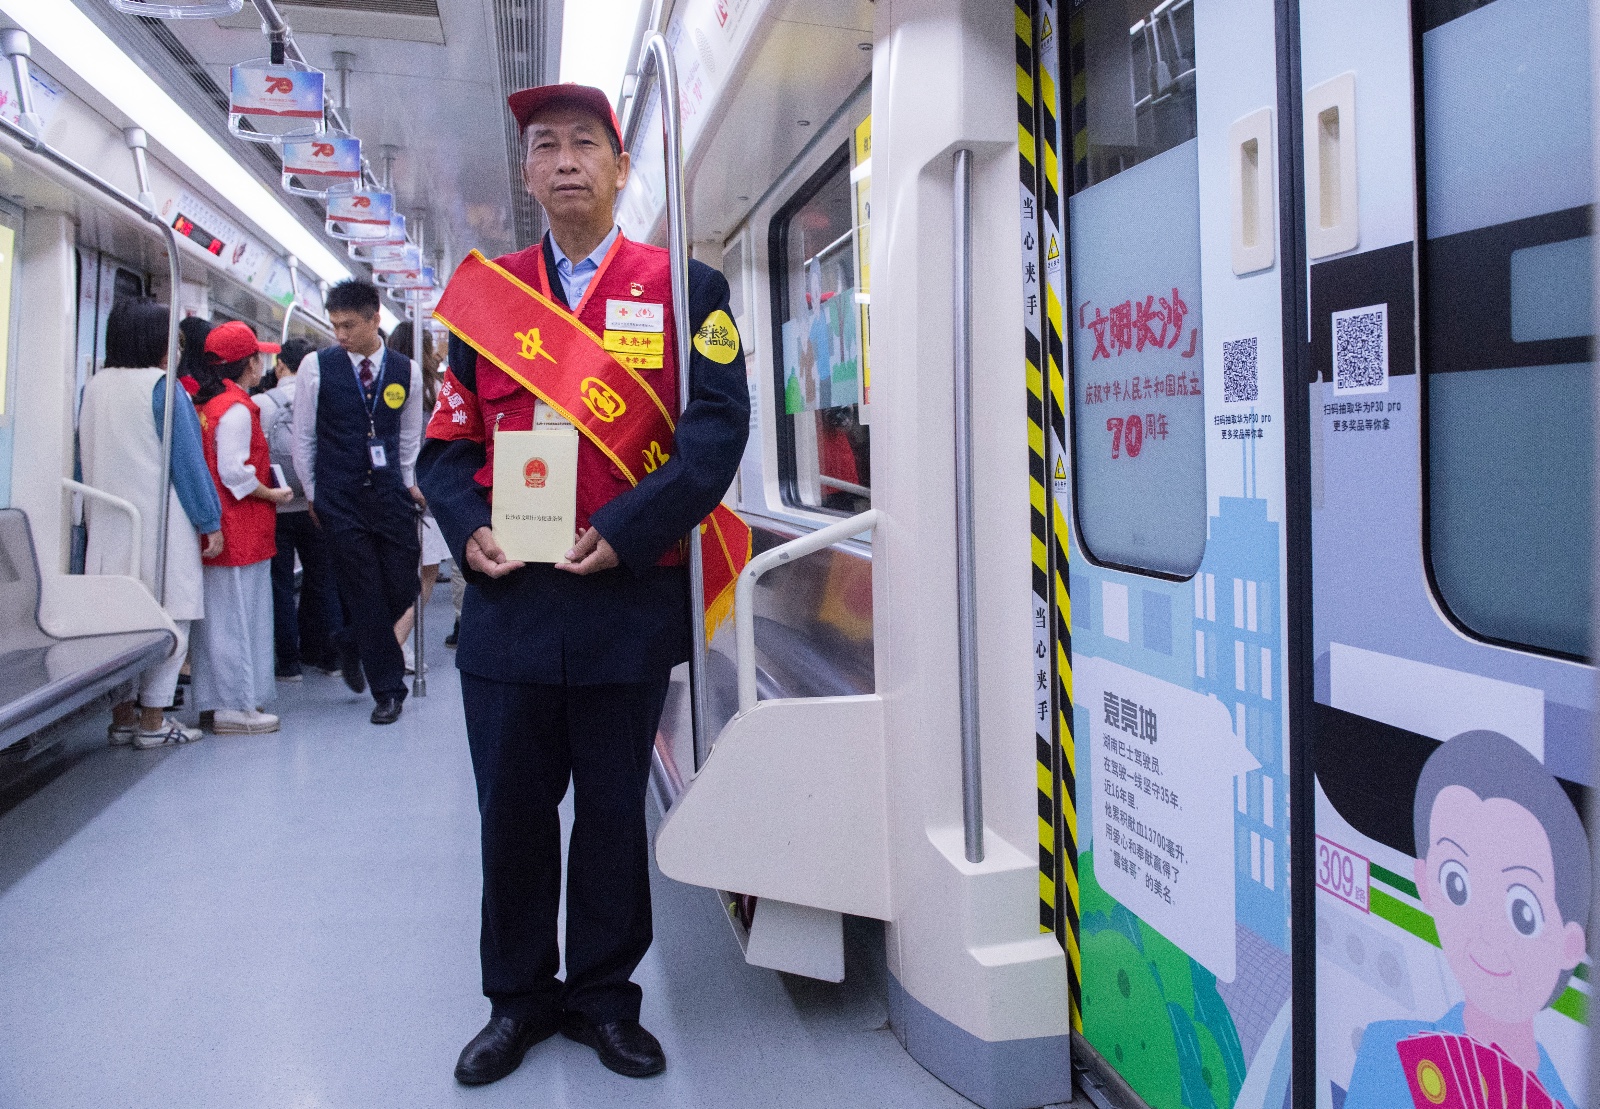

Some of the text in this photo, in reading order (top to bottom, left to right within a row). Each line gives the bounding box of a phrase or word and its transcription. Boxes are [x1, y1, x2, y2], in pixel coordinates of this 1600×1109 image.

[265, 74, 293, 94] 70
[311, 142, 335, 157] 70
[352, 195, 371, 208] 70
[1023, 196, 1038, 316] 当心夹手
[618, 335, 652, 348] 袁亮坤
[1085, 371, 1202, 405] 庆祝中华人民共和国成立
[441, 381, 468, 425] 志愿者
[1323, 400, 1401, 416] 扫码抽取华为P30 pro
[1221, 428, 1264, 440] 更多奖品等你拿
[1333, 418, 1390, 432] 更多奖品等你拿
[1035, 606, 1048, 721] 当心夹手
[1103, 690, 1158, 745] 袁亮坤
[1105, 823, 1180, 884] 用爱心和奉献赢得了
